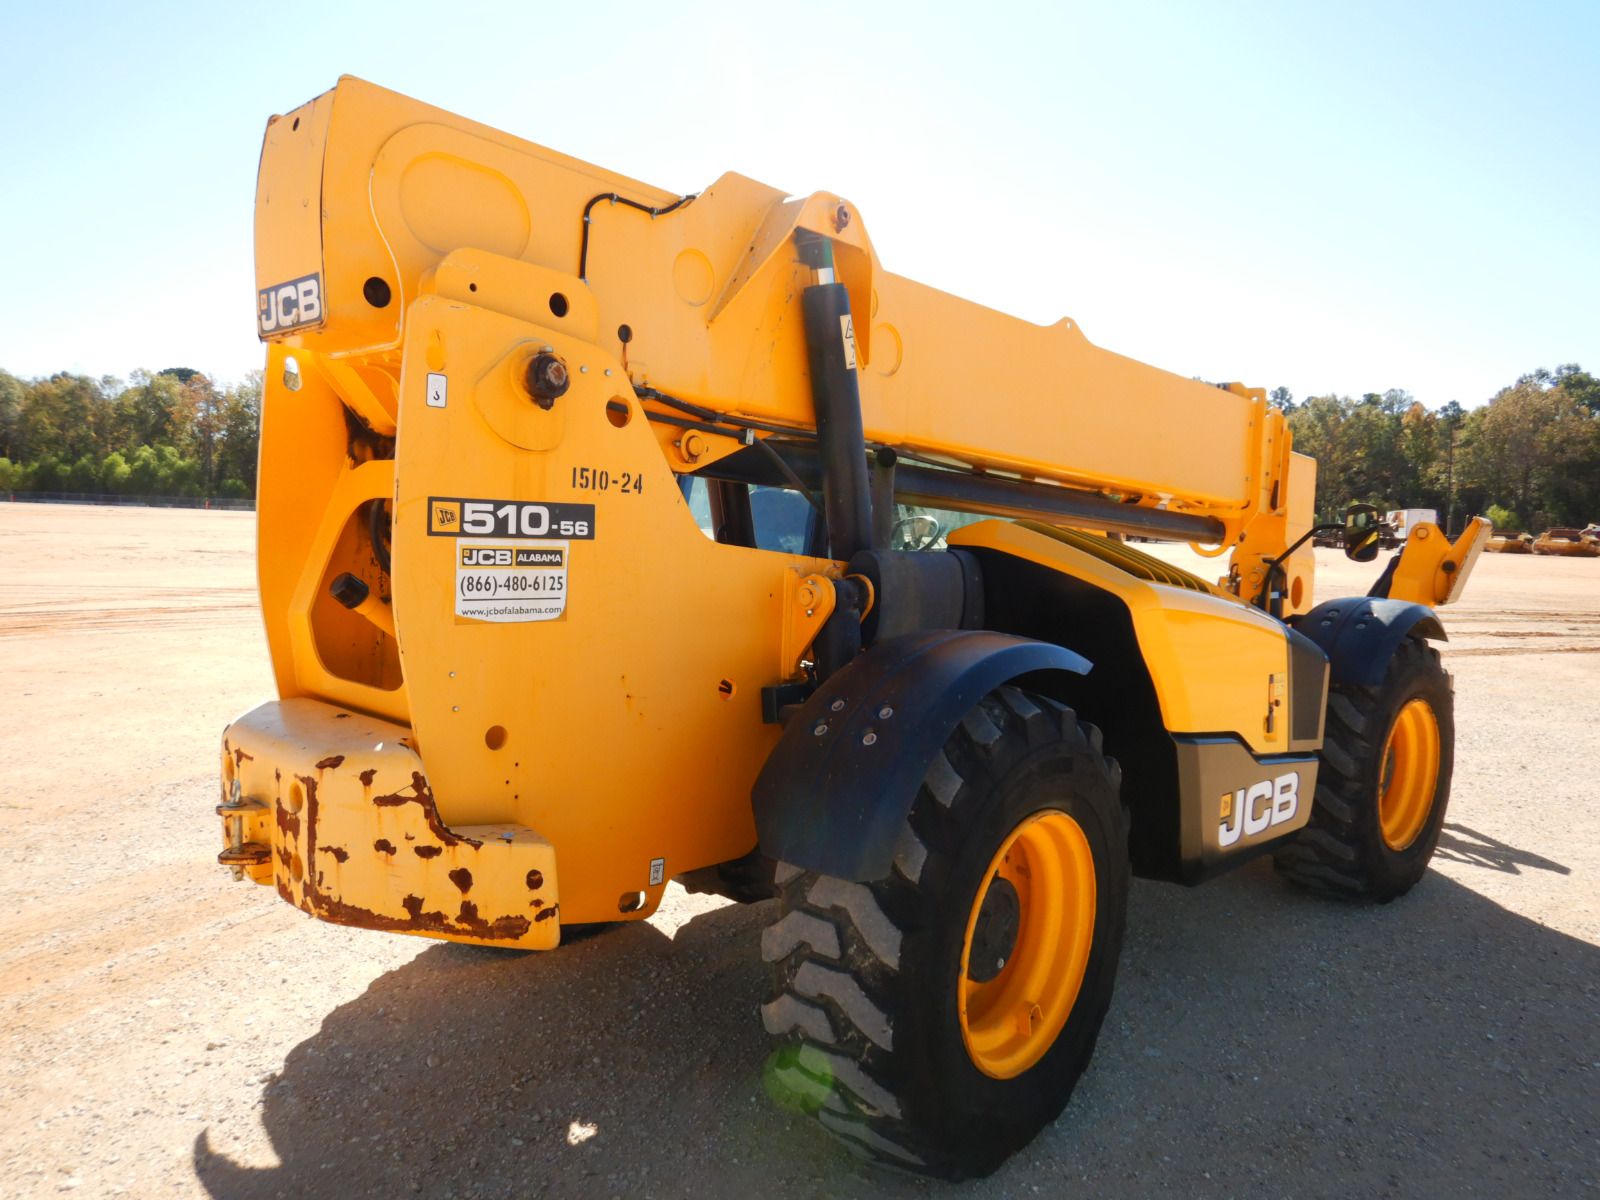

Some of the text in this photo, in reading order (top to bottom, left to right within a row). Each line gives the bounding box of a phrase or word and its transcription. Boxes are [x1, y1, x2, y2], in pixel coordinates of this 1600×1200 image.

[261, 279, 320, 331] JCB
[572, 467, 642, 494] 1510-24
[439, 502, 588, 536] JCB 510-56
[463, 549, 562, 566] JCB ALABAMA
[460, 575, 563, 597] (866)-480-6125
[461, 606, 562, 618] www.jcbofalabama.com
[1218, 772, 1299, 847] JCB
